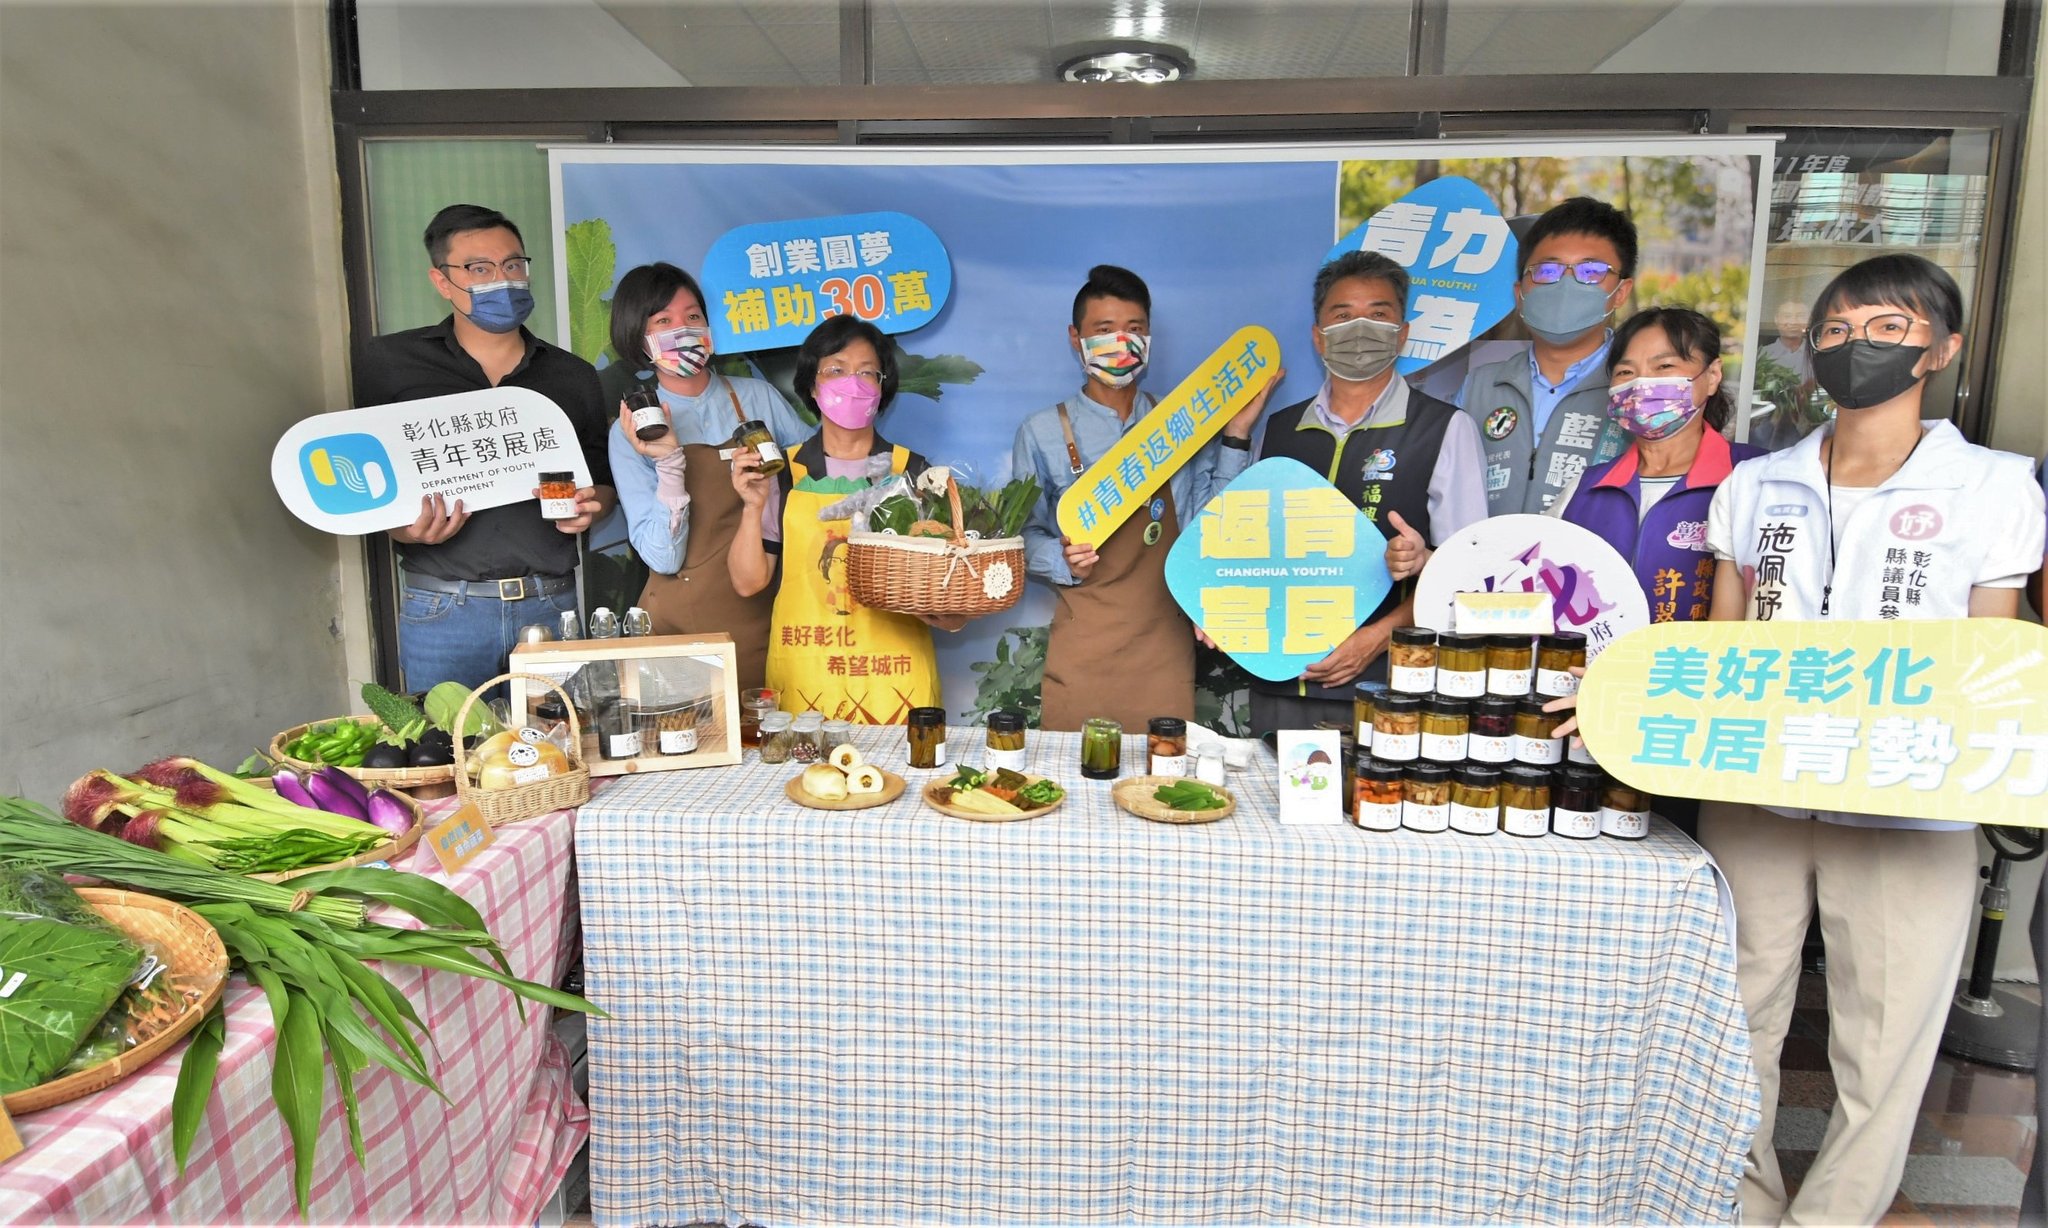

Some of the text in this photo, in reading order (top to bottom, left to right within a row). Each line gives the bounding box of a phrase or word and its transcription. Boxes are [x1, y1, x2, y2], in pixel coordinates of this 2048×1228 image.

[746, 231, 892, 278] 創業圓夢
[723, 271, 932, 334] 補助30萬
[1431, 279, 1478, 291] YOUTH!
[402, 406, 519, 443] 彰化縣政府
[1077, 340, 1266, 531] #青春返鄉生活式
[410, 427, 560, 474] 青年發展處
[421, 462, 536, 490] DEPARTMENT OF YOUTH
[426, 481, 495, 500] DVELOPMENT
[1898, 511, 1935, 537] 妤
[1216, 567, 1344, 577] CHANGHUA YOUTH!
[1755, 522, 1797, 621] 施佩妤
[1879, 547, 1907, 620] 縣議員參
[1906, 549, 1932, 607] 彰化縣
[781, 625, 856, 647] 美好彰化
[827, 655, 911, 676] 希望城市
[1646, 646, 1936, 706] 美好彰化
[1630, 712, 2048, 798] 宜居青勢力
